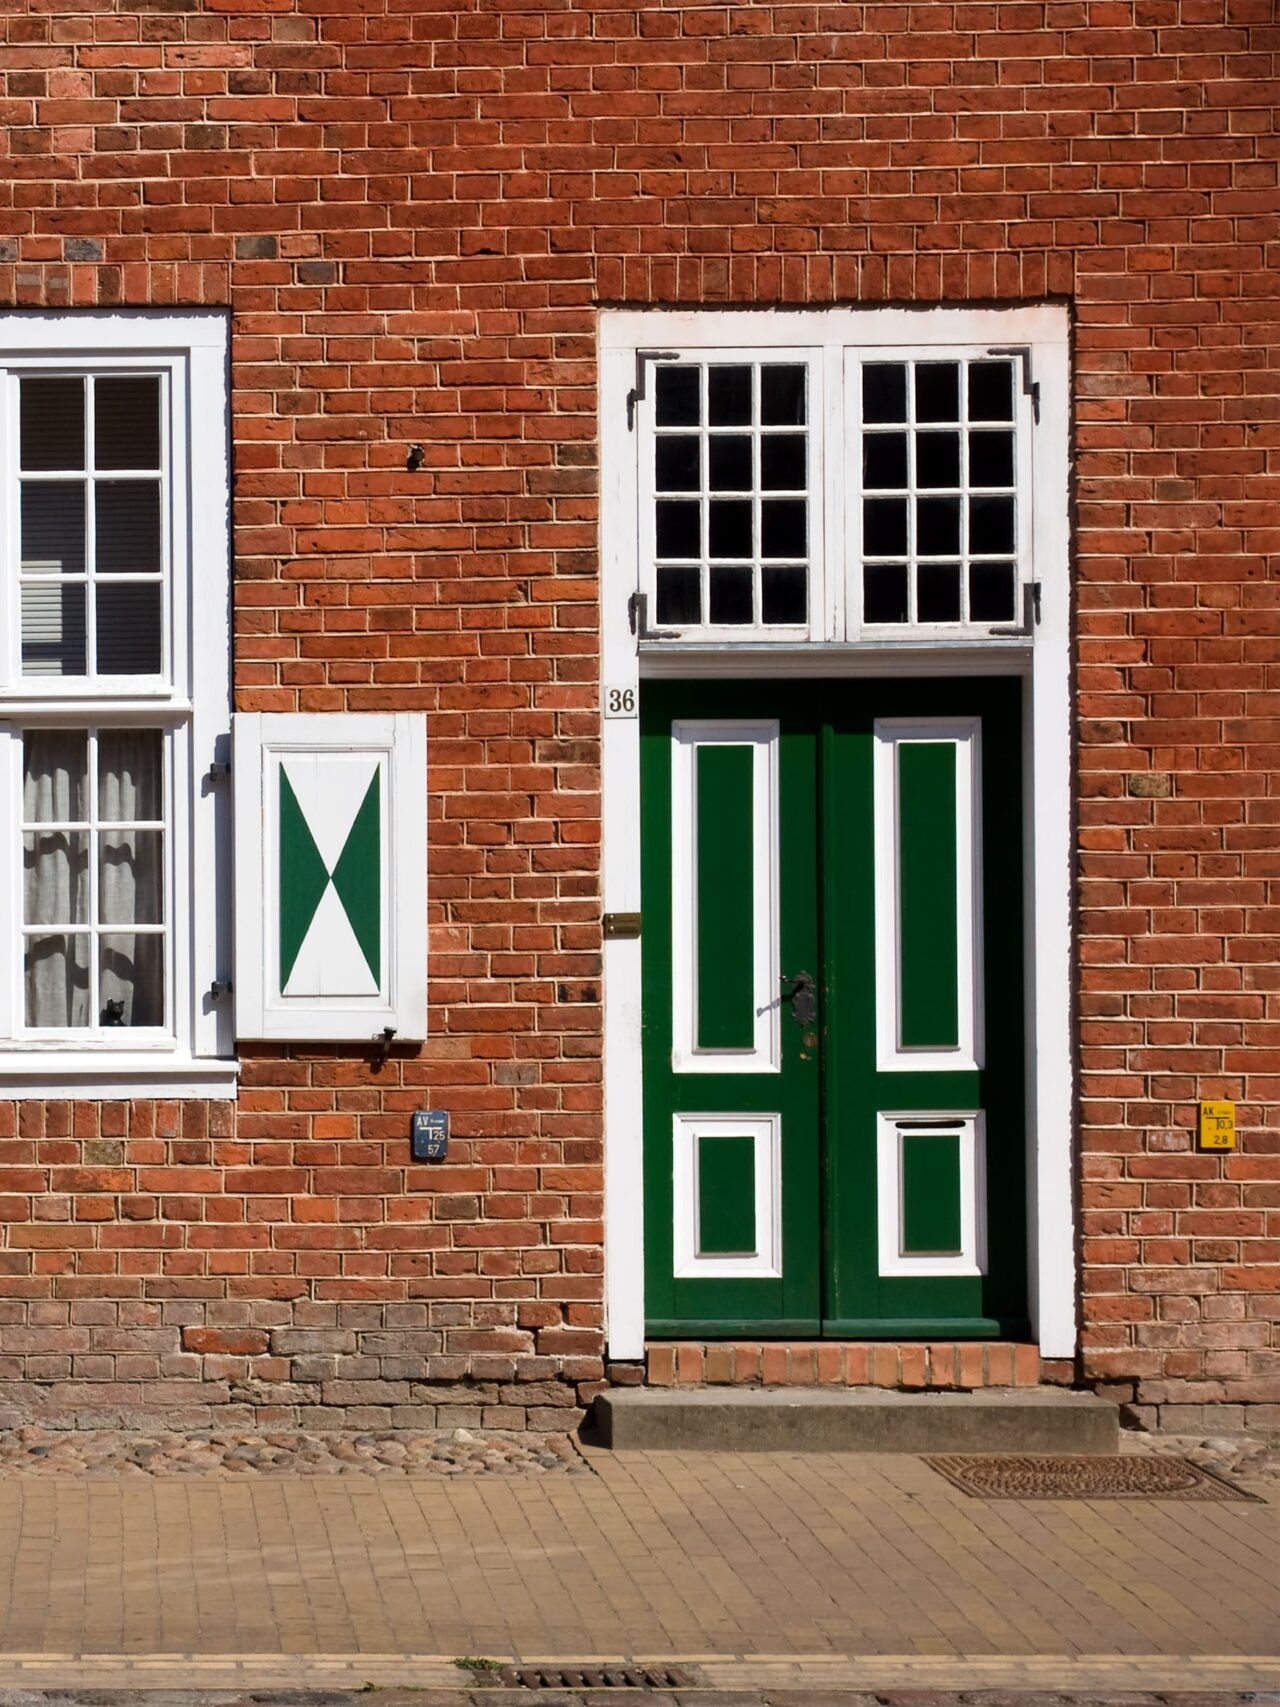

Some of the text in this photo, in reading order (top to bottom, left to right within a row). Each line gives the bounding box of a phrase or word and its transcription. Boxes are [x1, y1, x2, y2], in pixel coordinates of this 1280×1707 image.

[609, 688, 635, 712] 36
[1203, 1106, 1214, 1116] AK
[416, 1115, 429, 1126] AV
